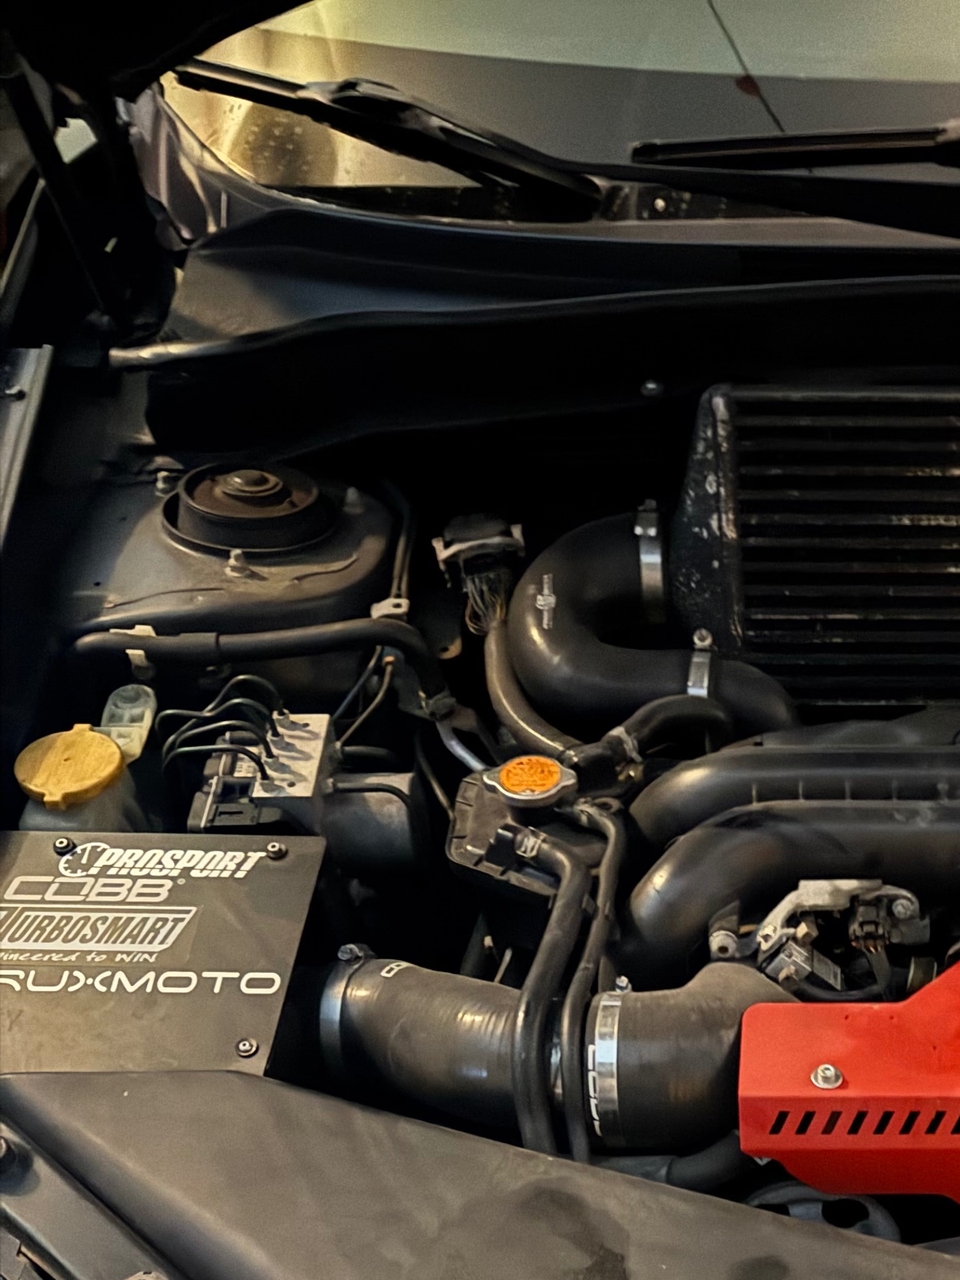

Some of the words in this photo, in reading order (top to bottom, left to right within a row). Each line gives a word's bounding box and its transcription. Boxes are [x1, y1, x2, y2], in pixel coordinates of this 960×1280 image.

[88, 848, 267, 879] PROSPORT
[4, 875, 173, 902] COBB
[0, 950, 81, 962] ineered
[86, 951, 107, 962] to
[115, 951, 158, 963] WIN
